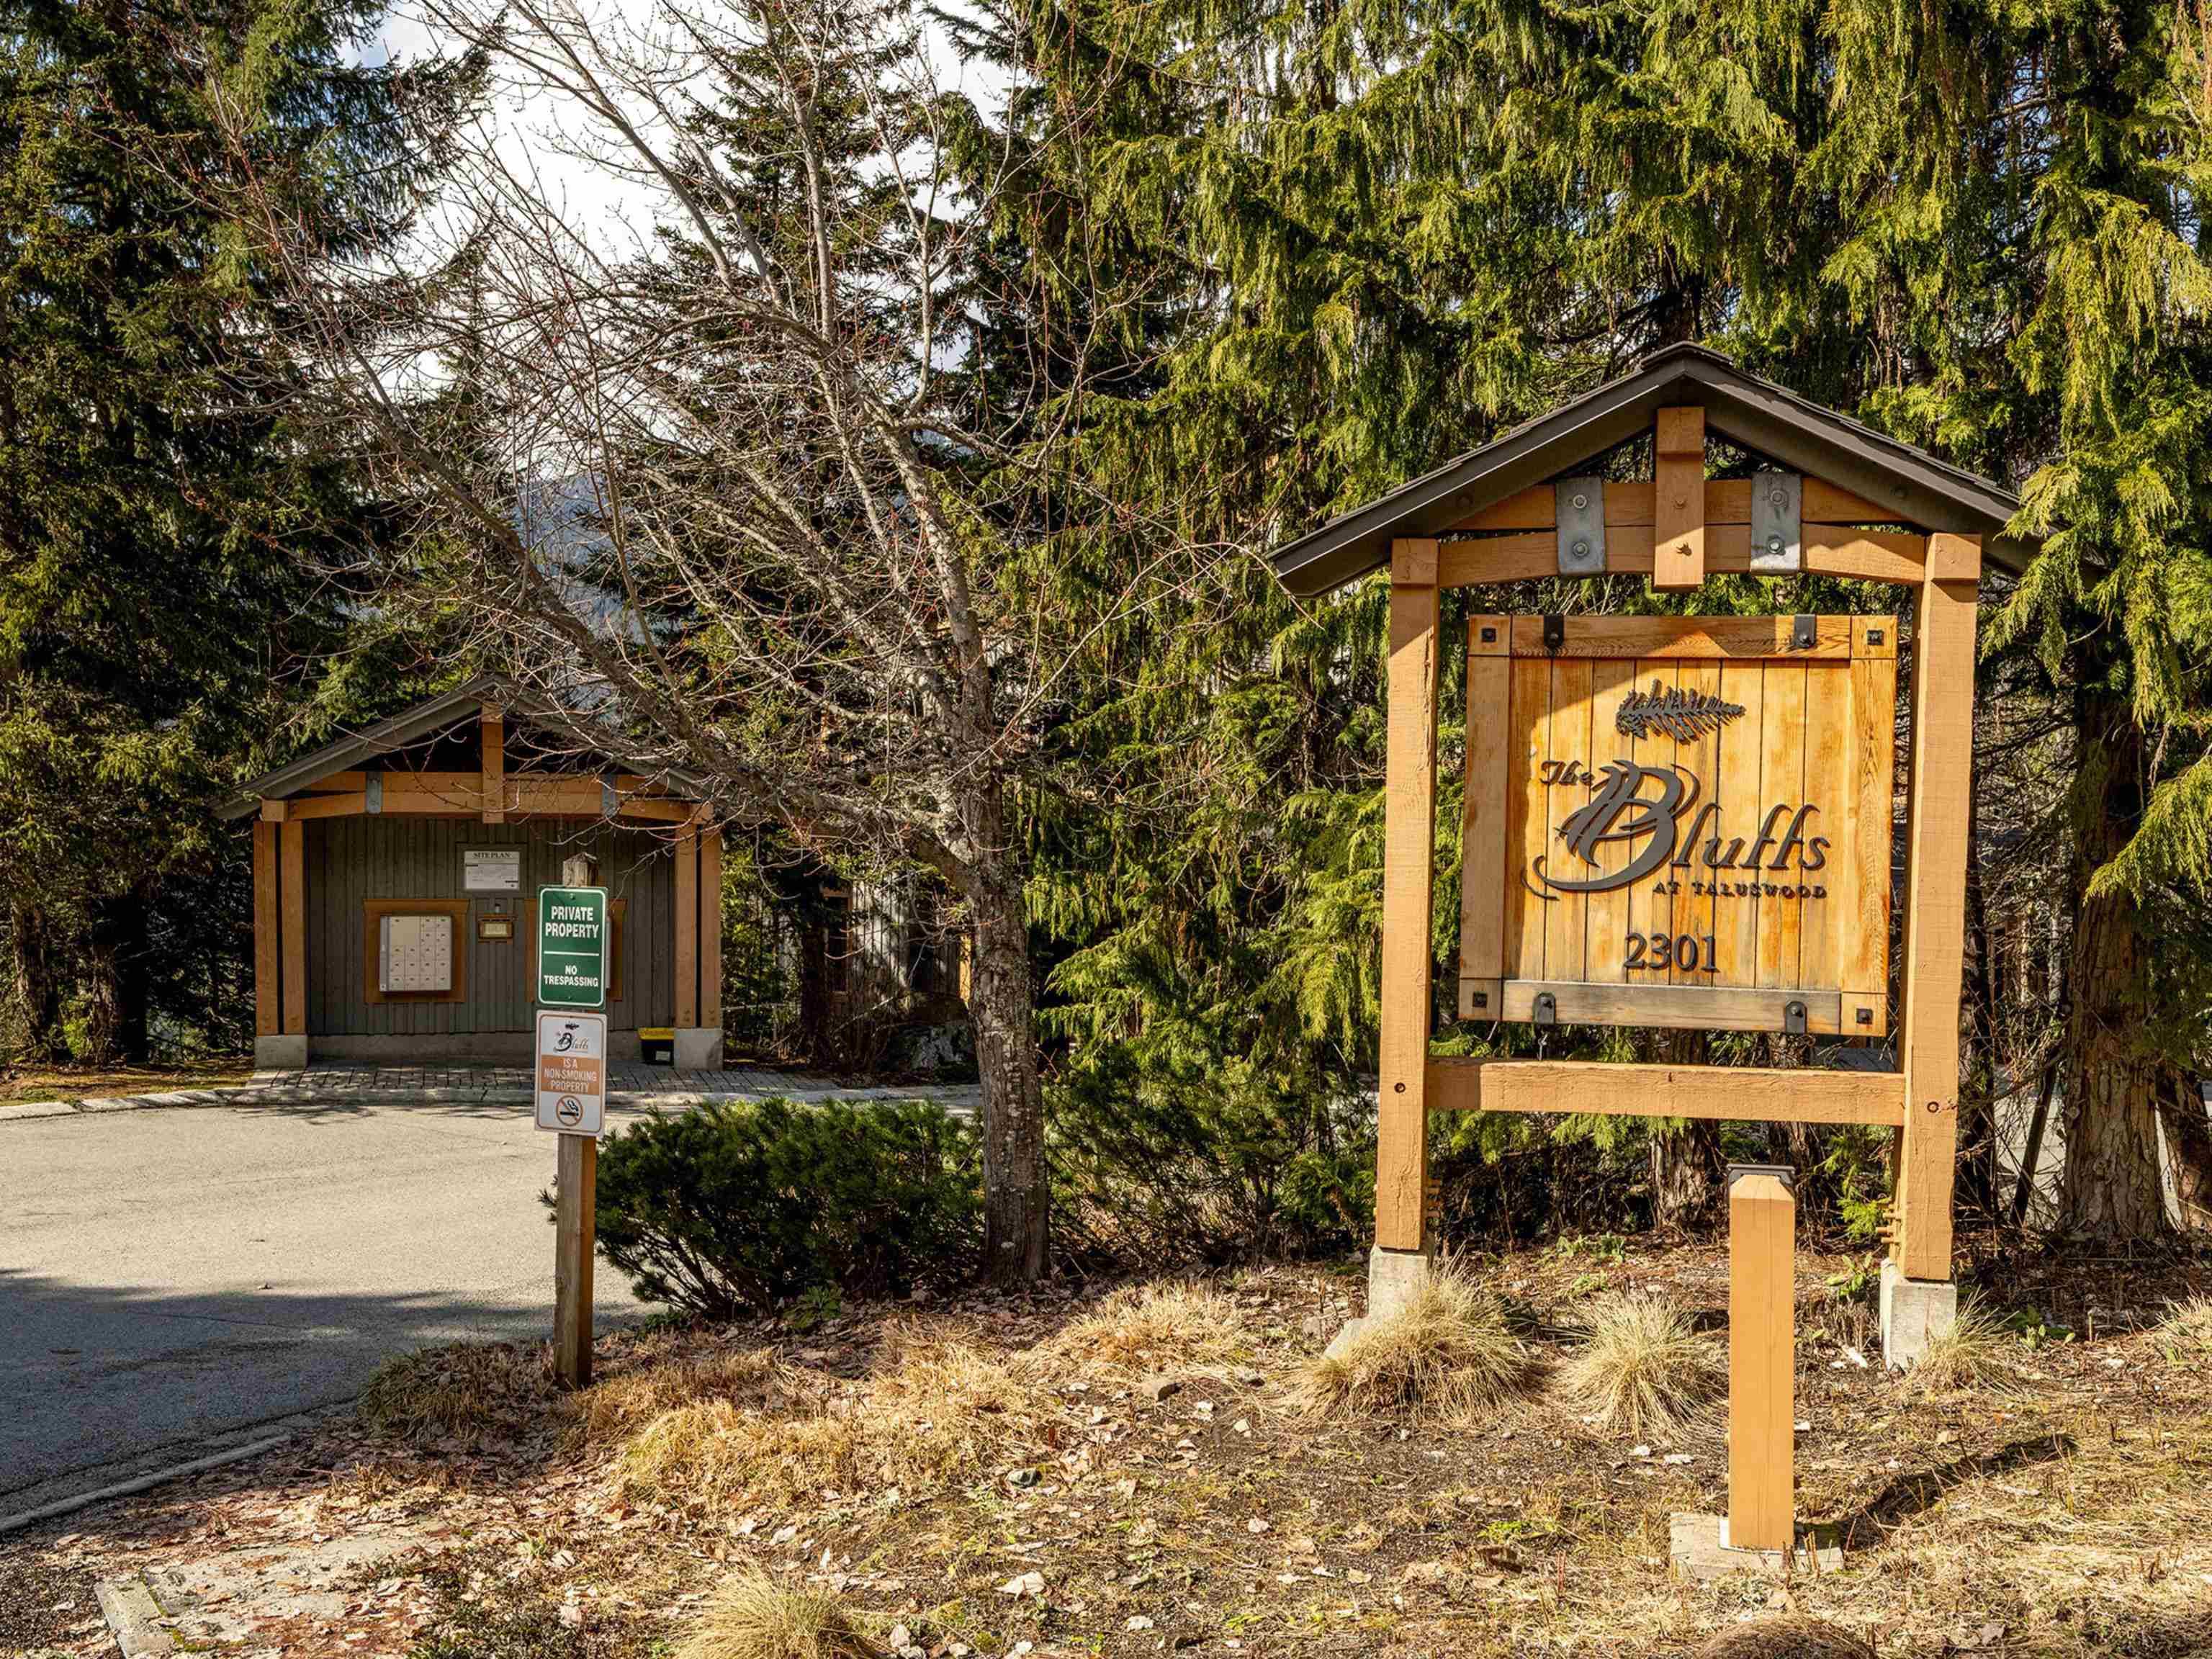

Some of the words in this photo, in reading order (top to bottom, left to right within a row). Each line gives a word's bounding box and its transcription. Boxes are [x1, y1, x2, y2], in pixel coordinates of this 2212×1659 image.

[1540, 759, 1595, 786] The
[1521, 760, 1831, 901] Bluffs
[1653, 881, 1679, 896] AT
[1692, 881, 1827, 899] TALUSWOOD
[551, 906, 594, 922] PRIVATE
[545, 922, 600, 939] PROPERTY
[1623, 932, 1721, 974] 2301
[565, 965, 577, 976] NO
[544, 975, 599, 987] TRESPASSING
[563, 1058, 571, 1068] IS
[572, 1058, 577, 1069] A
[550, 1080, 590, 1093] PROPERTY
